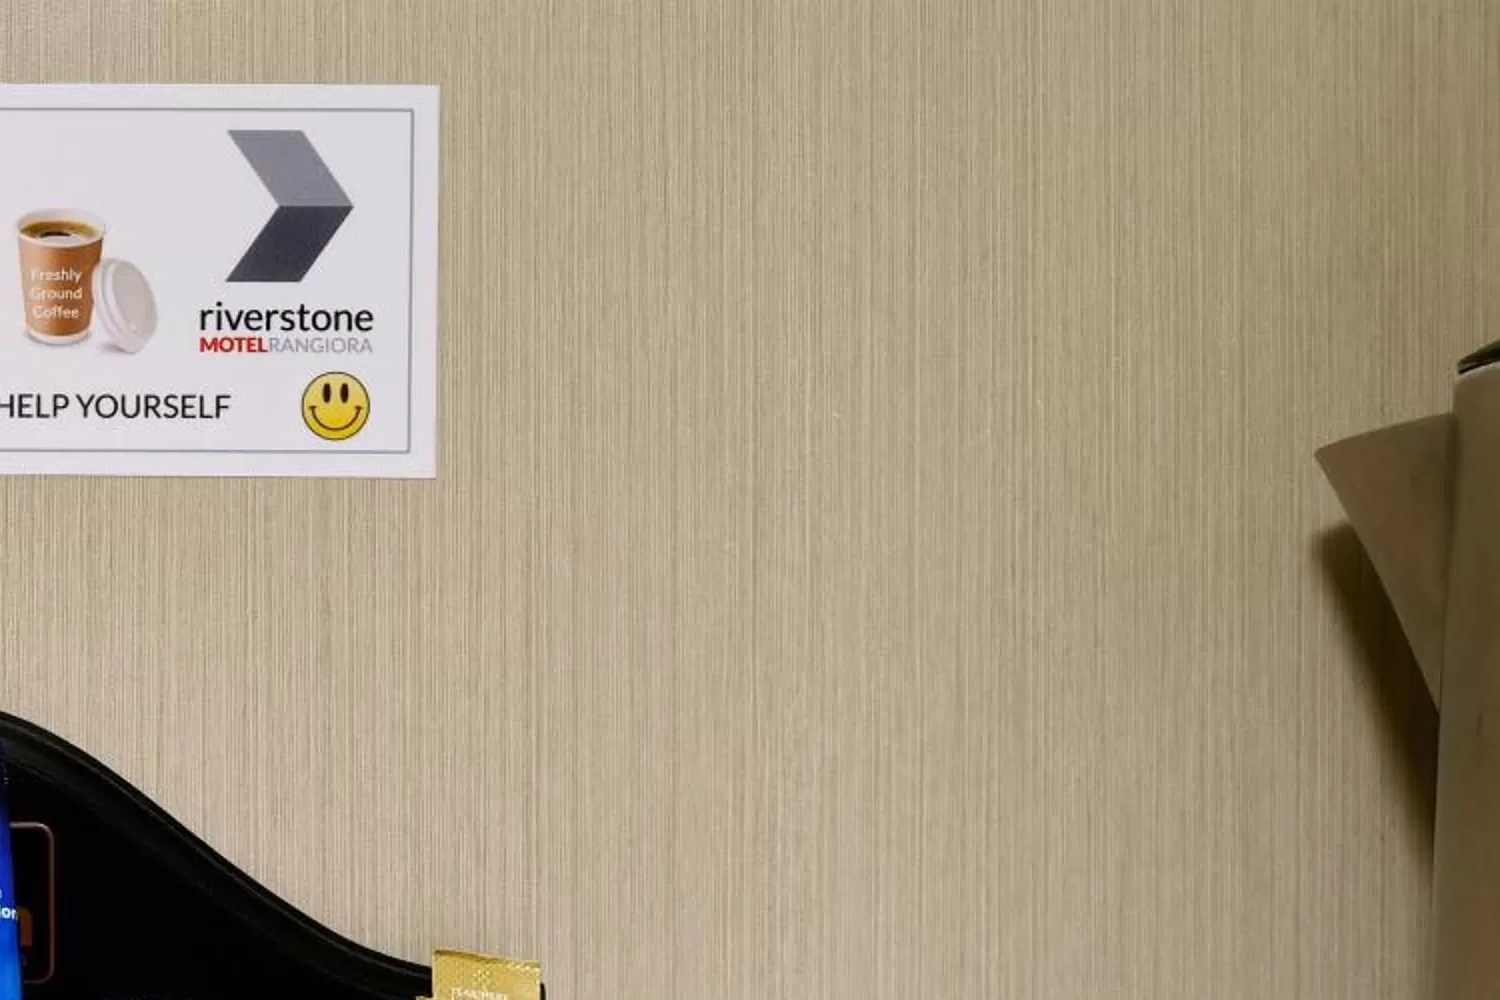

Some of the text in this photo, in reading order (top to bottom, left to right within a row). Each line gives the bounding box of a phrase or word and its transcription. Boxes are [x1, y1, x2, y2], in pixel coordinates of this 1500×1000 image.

[31, 267, 83, 283] Freshly
[31, 287, 83, 300] Ground
[33, 305, 79, 318] Coffee
[200, 301, 374, 332] riverstone
[75, 394, 231, 420] YOURSELF
